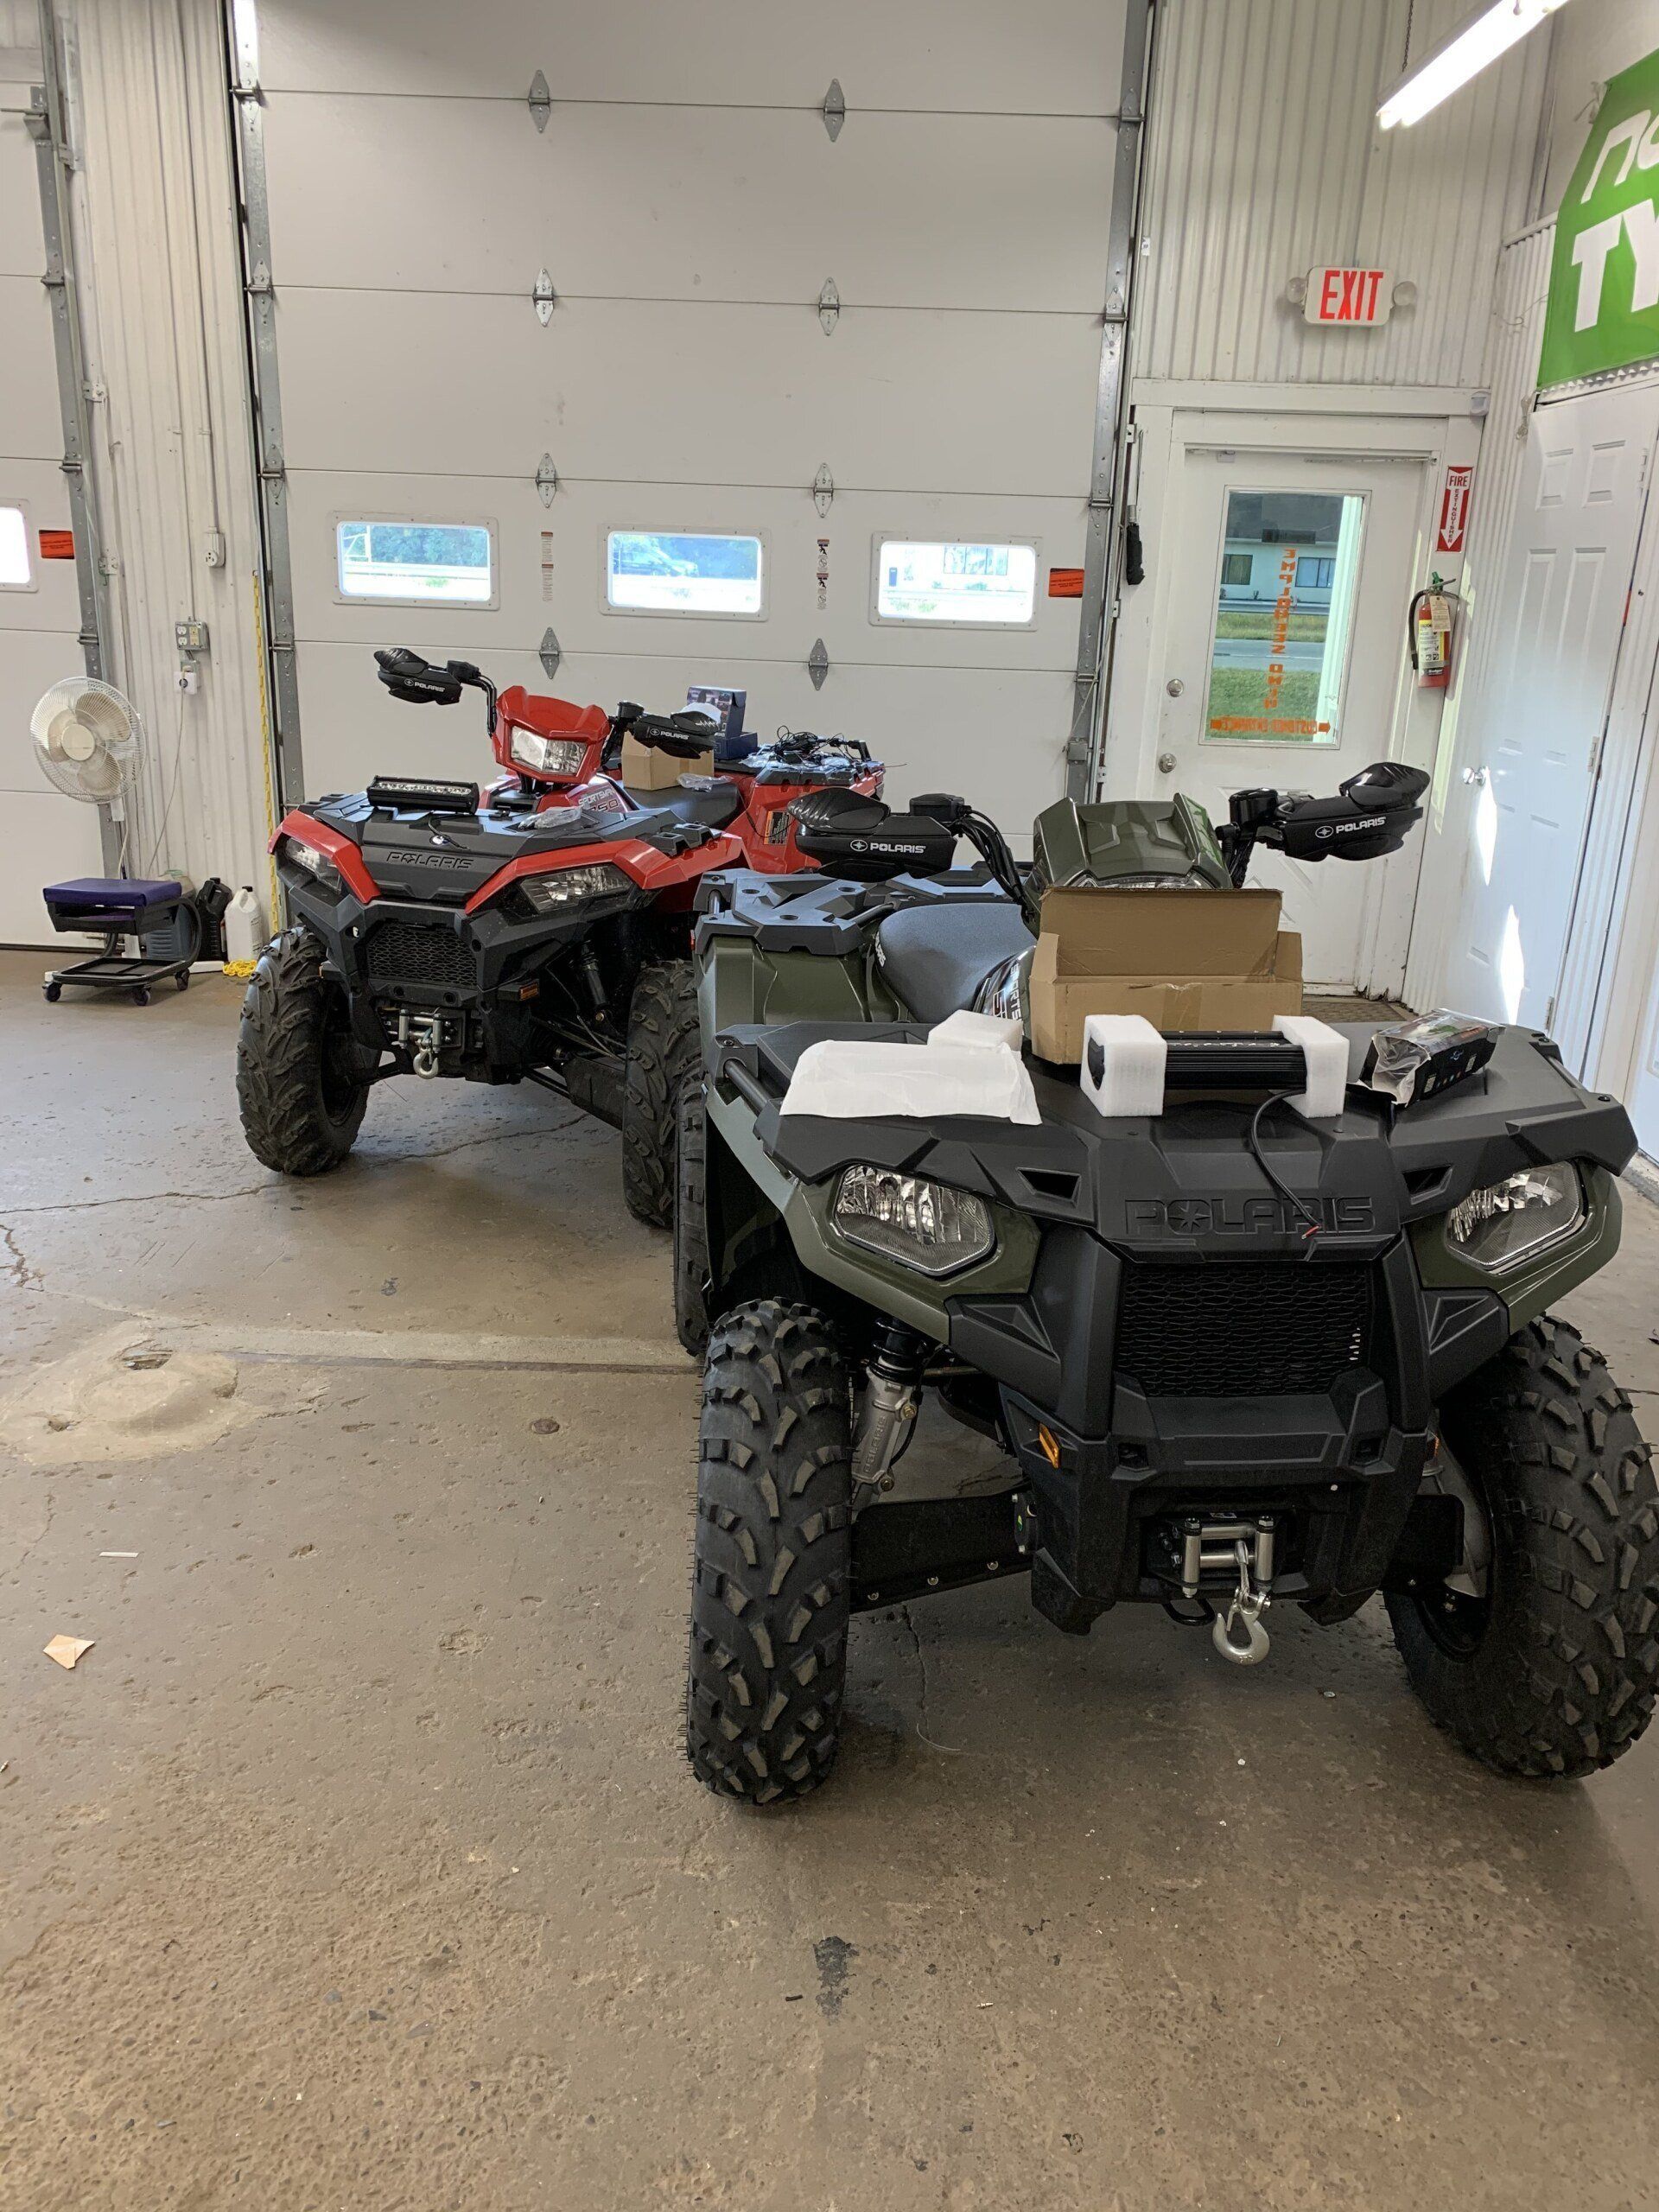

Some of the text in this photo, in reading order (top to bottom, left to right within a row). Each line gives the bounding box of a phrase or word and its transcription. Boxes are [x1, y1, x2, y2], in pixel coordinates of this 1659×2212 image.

[1319, 270, 1384, 321] EXIT
[1448, 475, 1469, 486] FIRE
[1447, 488, 1459, 543] EXTINGUISHER
[414, 682, 445, 692] POLARIS
[660, 730, 690, 741] POLARIS
[1335, 817, 1386, 834] POLARIS
[870, 842, 926, 854] POLARIS
[386, 851, 474, 869] POLARIS
[1124, 1198, 1376, 1236] POLARIS
